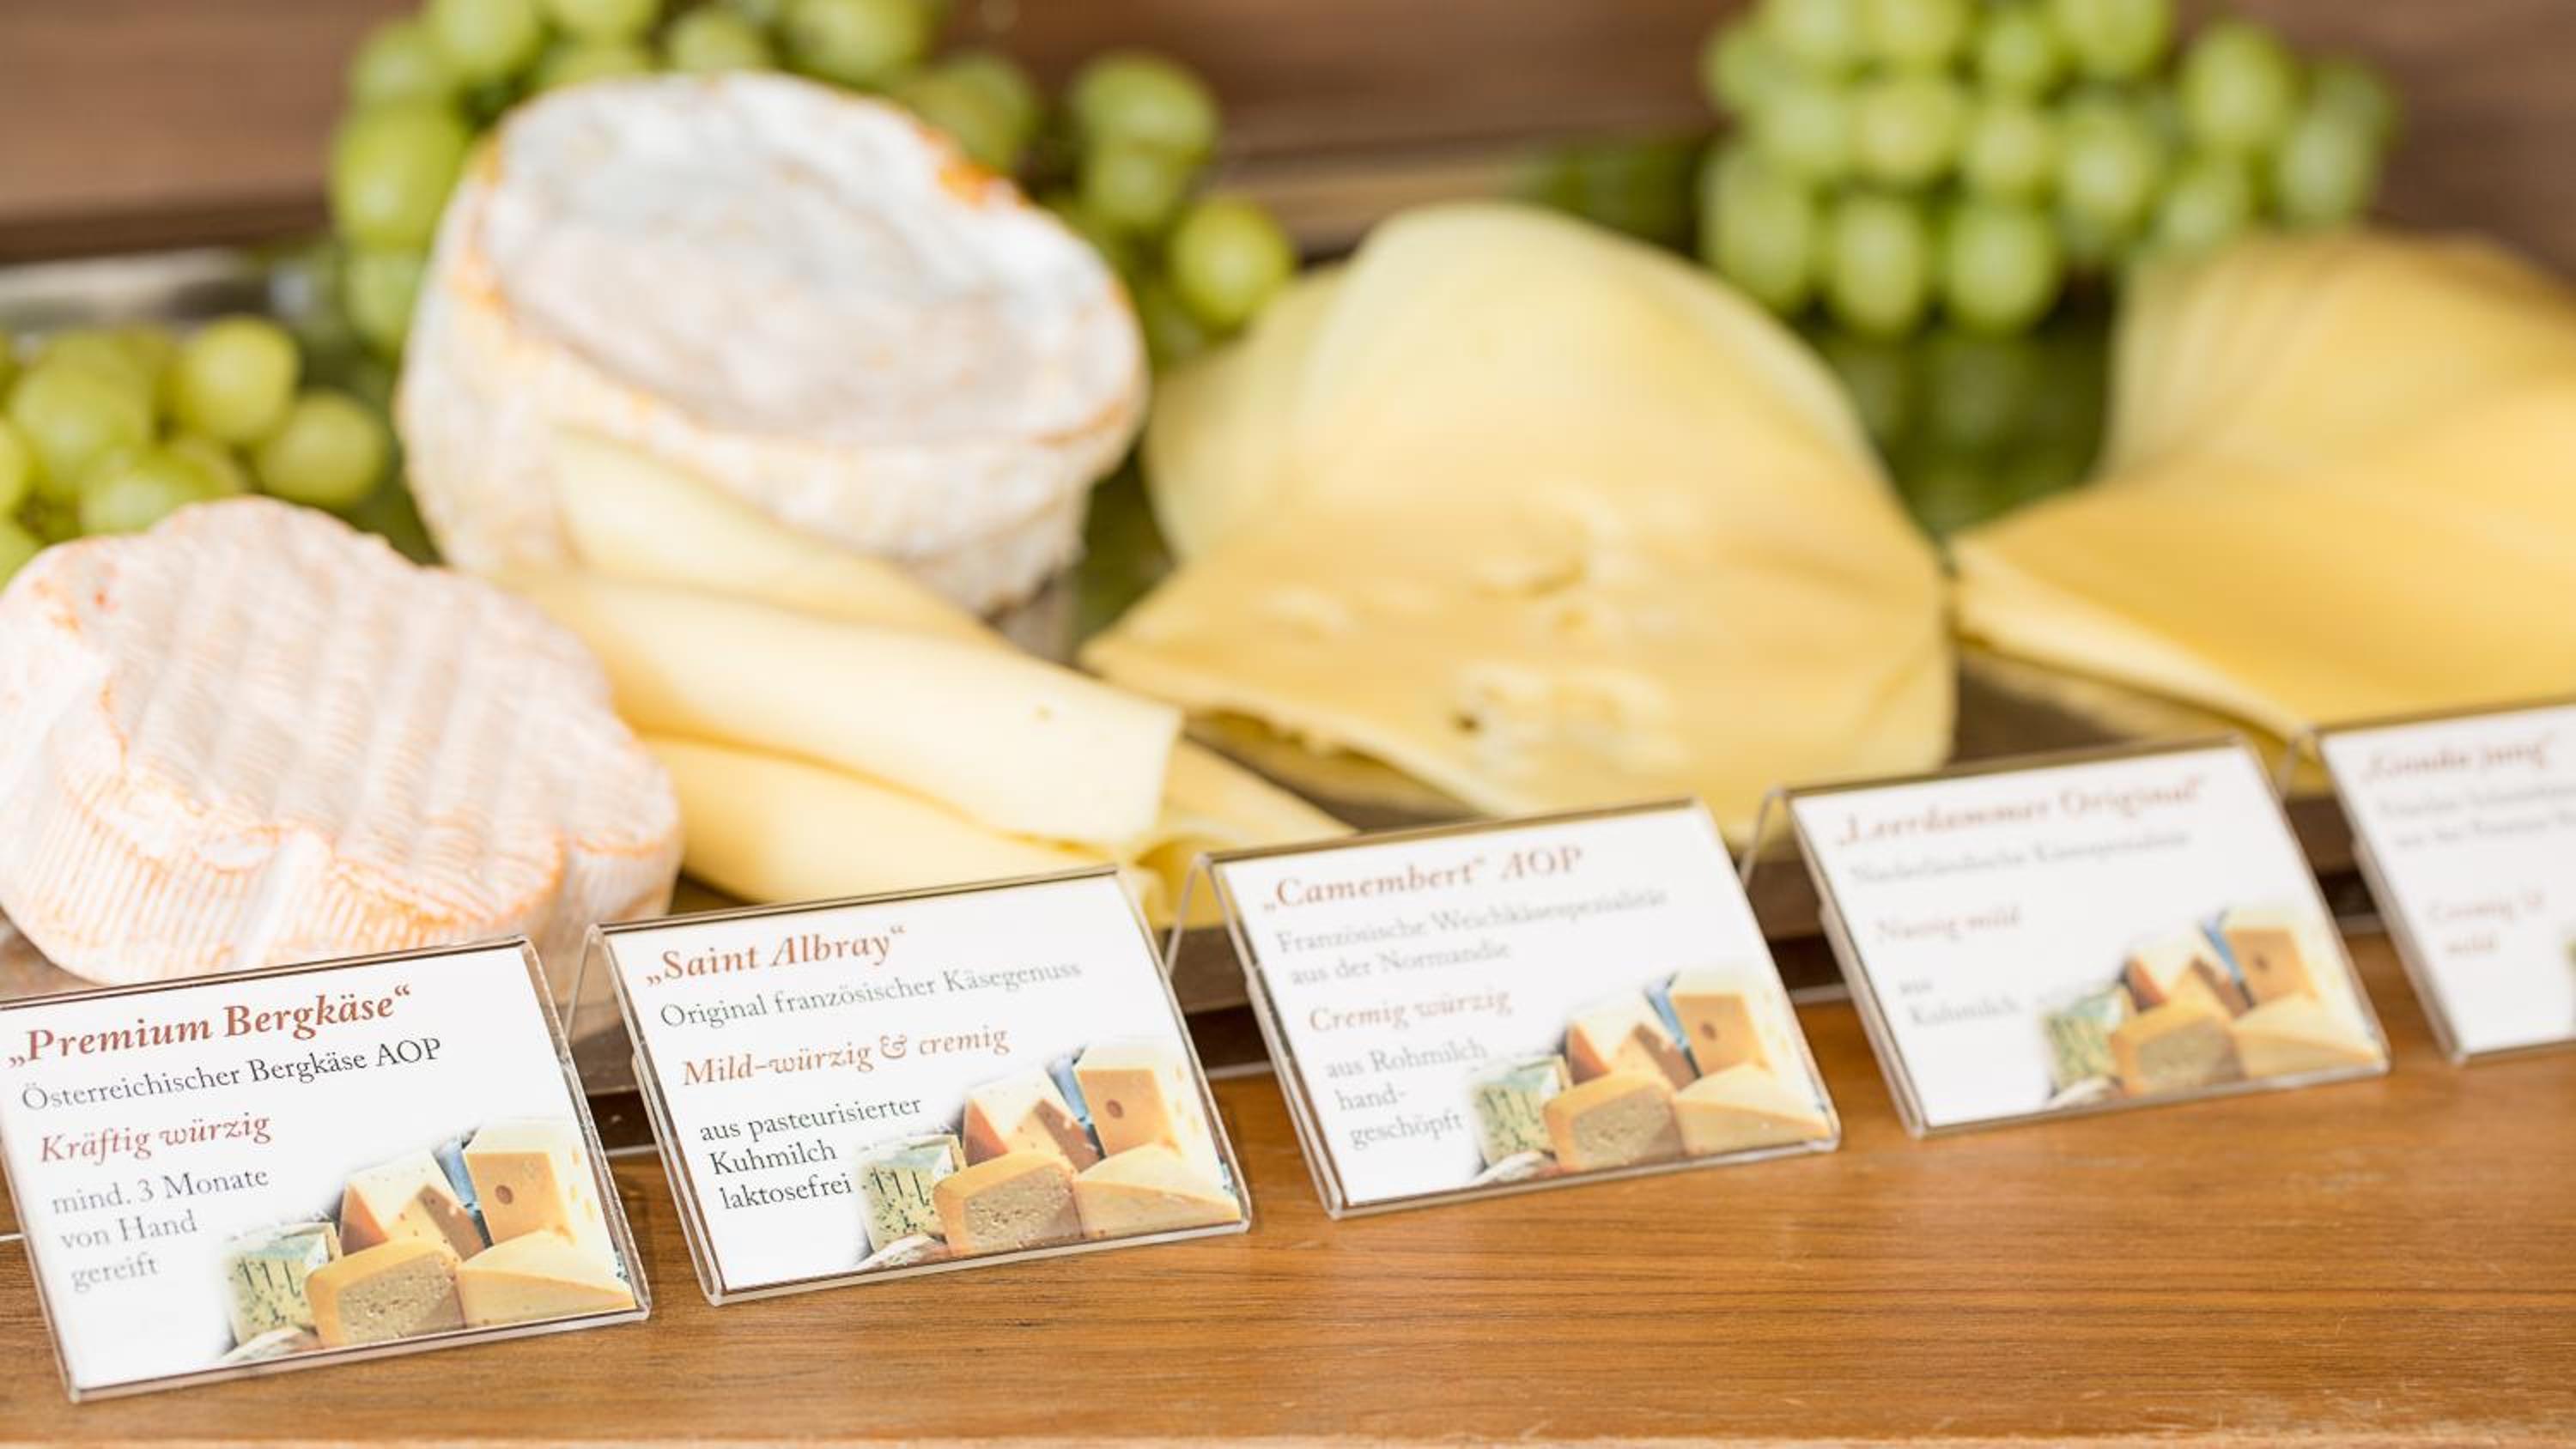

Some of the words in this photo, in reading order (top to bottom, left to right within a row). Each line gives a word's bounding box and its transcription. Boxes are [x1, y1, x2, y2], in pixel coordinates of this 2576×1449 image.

[1501, 846, 1583, 881] AOP
[646, 945, 759, 986] „Saint
[772, 924, 906, 970] Albray“
[1276, 915, 1426, 954] Französische
[1291, 965, 1328, 985] aus
[1334, 955, 1372, 980] der
[1381, 940, 1510, 973] Normandie
[660, 994, 769, 1031] Original
[774, 975, 935, 1016] französischer
[945, 961, 1081, 993] Käsegenuss
[1309, 1000, 1410, 1033] Cremig
[1414, 986, 1513, 1017] würzig
[9, 1015, 212, 1066] „Premium
[222, 984, 410, 1040] Bergkäse“
[21, 1065, 240, 1111] Österreichischer
[250, 1049, 368, 1086] Bergkäse
[374, 1038, 442, 1068] AOP
[682, 1043, 874, 1087] Mild-würzig
[879, 1035, 908, 1060] &
[917, 1026, 1009, 1058] cremig
[1325, 1059, 1366, 1079] aus
[1370, 1039, 1487, 1073] Rohmilch
[699, 1119, 741, 1142] aus
[747, 1096, 922, 1143] pasteurisierter
[1338, 1086, 1406, 1112] hand-
[40, 1125, 154, 1165] Kräftig
[159, 1113, 271, 1147] würzig
[1349, 1109, 1465, 1149] geschöpft
[52, 1185, 133, 1214] mind.
[138, 1179, 155, 1203] 3
[162, 1167, 269, 1197] Monate
[720, 1172, 853, 1210] laktosefrei
[61, 1225, 110, 1250] von
[118, 1210, 198, 1241] Hand
[70, 1253, 161, 1292] gereift
